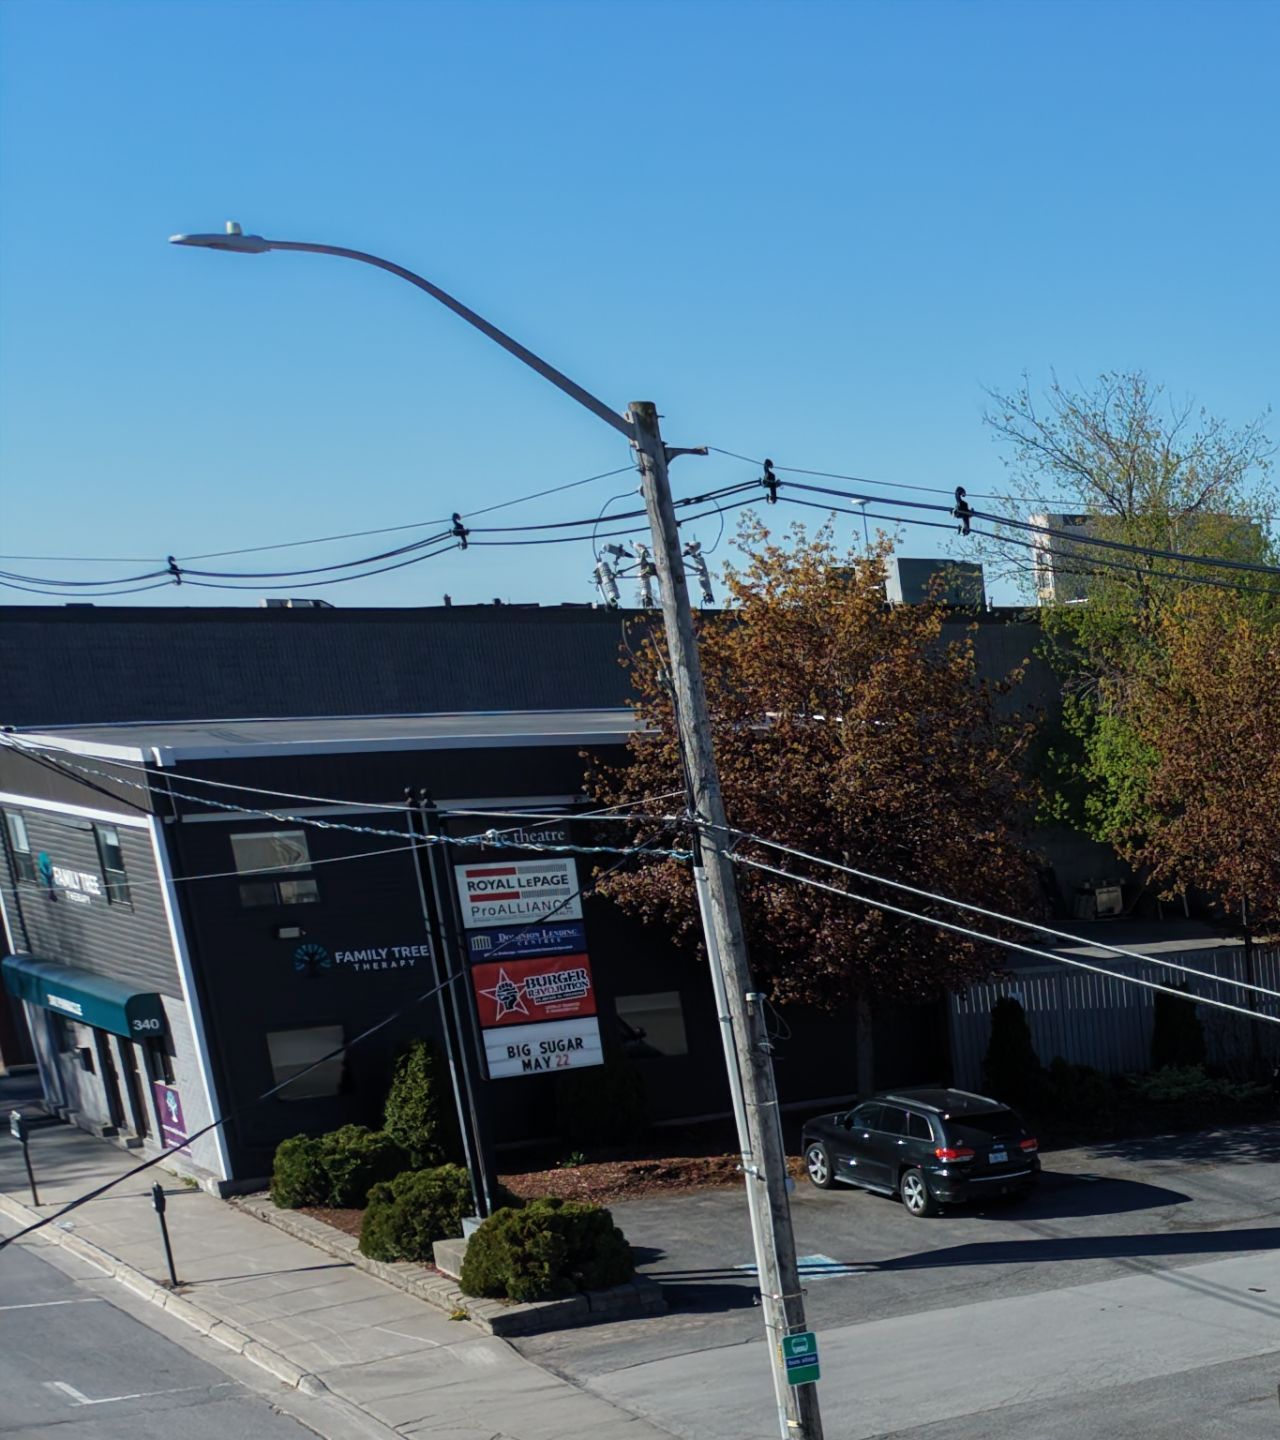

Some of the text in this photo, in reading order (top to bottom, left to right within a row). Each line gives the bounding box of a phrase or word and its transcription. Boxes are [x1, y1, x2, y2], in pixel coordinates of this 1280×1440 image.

[513, 827, 566, 844] theatre
[467, 877, 515, 892] ROYAL
[471, 899, 573, 917] ProALLIANCE
[335, 944, 430, 964] FAMILY TREE
[354, 959, 416, 972] THERAPY
[525, 968, 588, 989] BURGER
[132, 1018, 160, 1031] 340
[507, 1037, 584, 1059] BIG SUGAR
[521, 1053, 571, 1072] MAY 22
